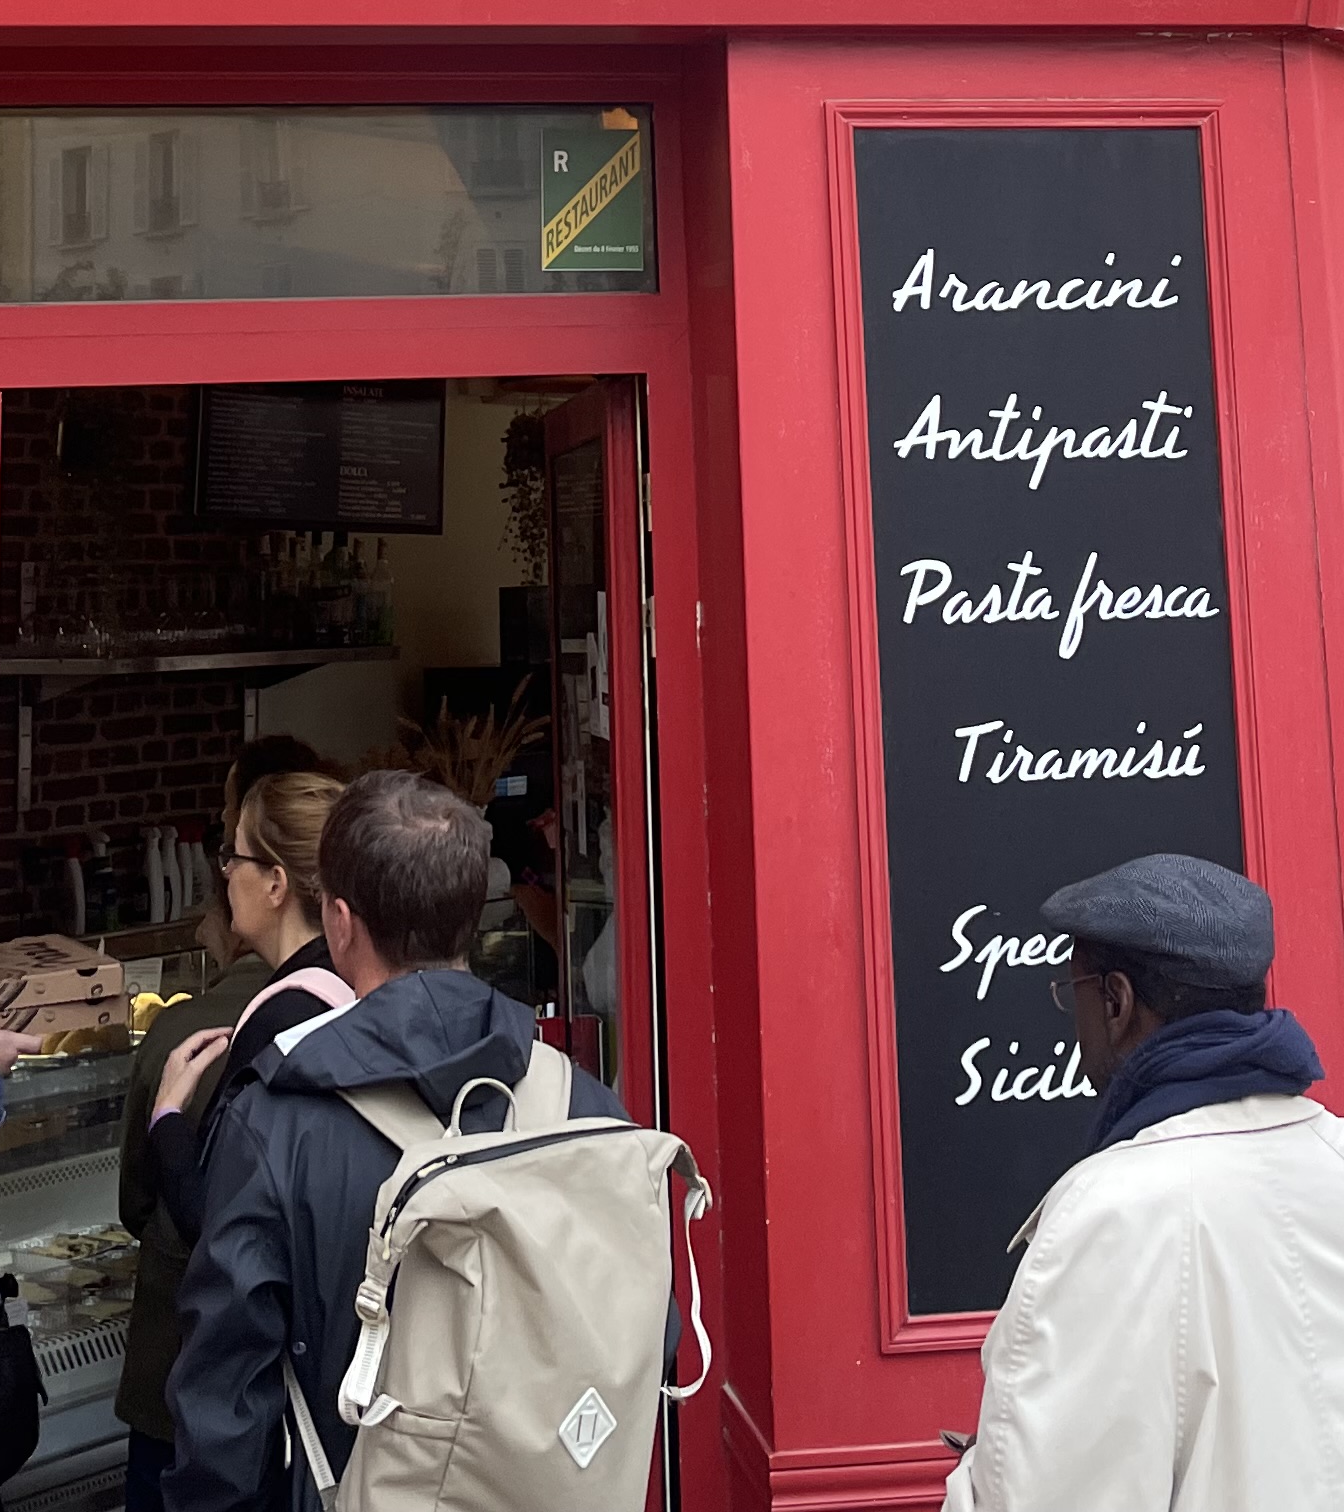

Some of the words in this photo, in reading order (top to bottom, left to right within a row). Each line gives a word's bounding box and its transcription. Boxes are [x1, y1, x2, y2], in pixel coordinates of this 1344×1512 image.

[545, 140, 639, 259] RESTAURANT
[552, 149, 569, 173] R
[893, 248, 1183, 312] Arancini
[893, 390, 1194, 491] Antipasti
[899, 550, 1060, 625] Pasta
[1058, 551, 1221, 660] fresca
[939, 904, 1074, 1001] Spec
